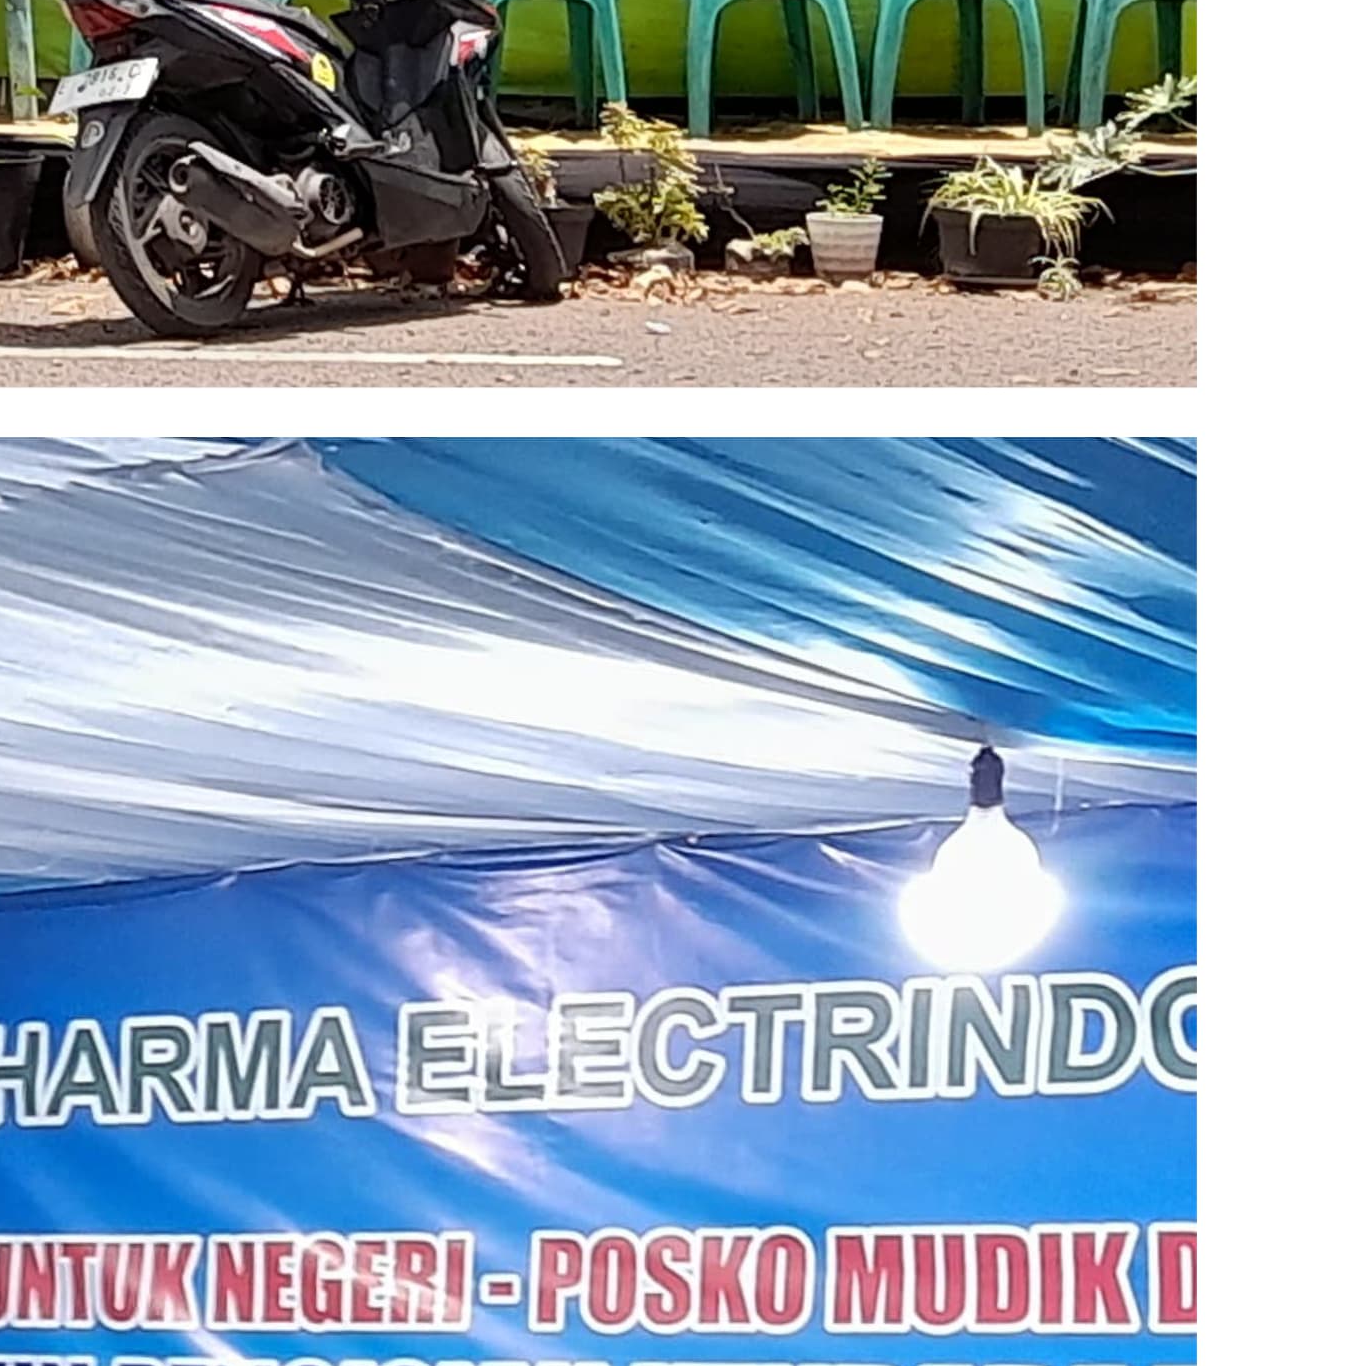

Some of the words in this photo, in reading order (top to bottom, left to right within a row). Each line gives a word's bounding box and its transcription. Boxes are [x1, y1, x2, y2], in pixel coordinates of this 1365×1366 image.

[211, 1235, 471, 1331] NEGERI
[531, 1229, 813, 1332] POSKO
[828, 1226, 1137, 1332] MUDIK
